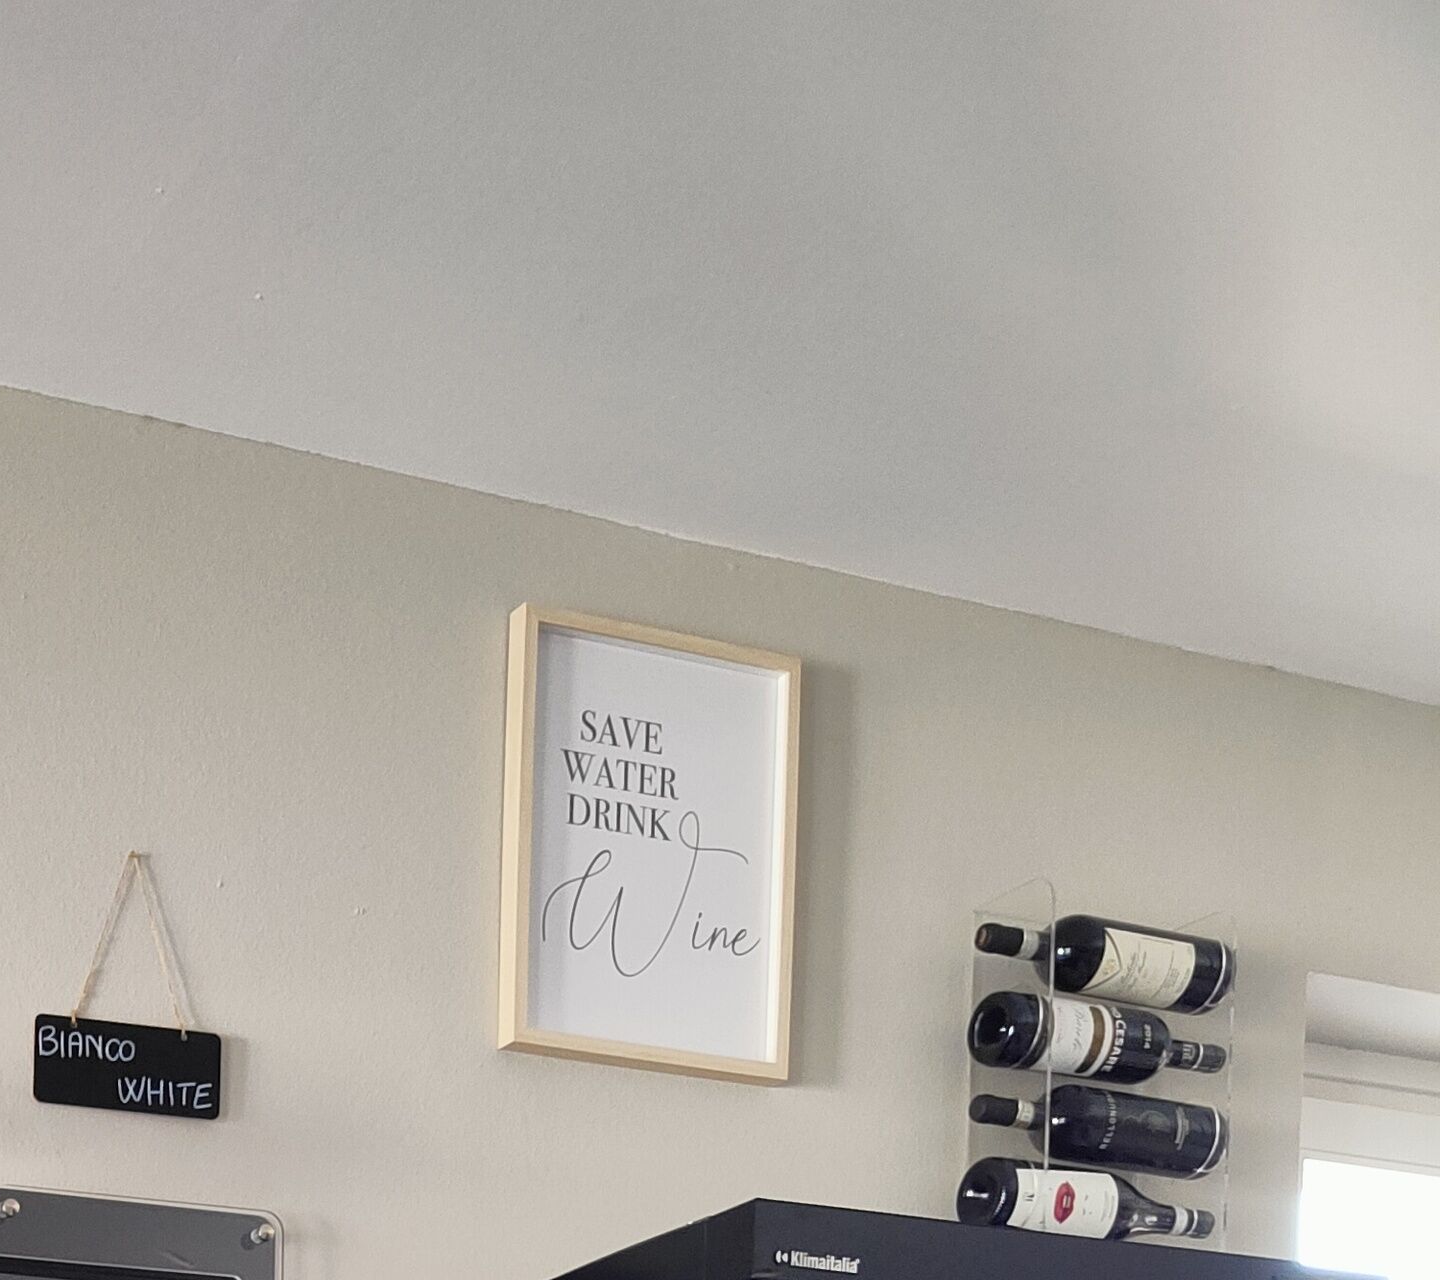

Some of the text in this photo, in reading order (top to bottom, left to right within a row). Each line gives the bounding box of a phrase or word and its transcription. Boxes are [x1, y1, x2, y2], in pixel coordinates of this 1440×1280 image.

[580, 709, 663, 755] SAVE
[560, 748, 679, 800] WATER
[566, 793, 672, 841] DRINK
[542, 811, 760, 977] Wine
[38, 1023, 136, 1062] BIANCO
[1101, 1017, 1128, 1074] CESARE
[1142, 1023, 1153, 1050] 2014
[117, 1076, 214, 1110] WHITE
[791, 1250, 859, 1274] Klimaitalia
